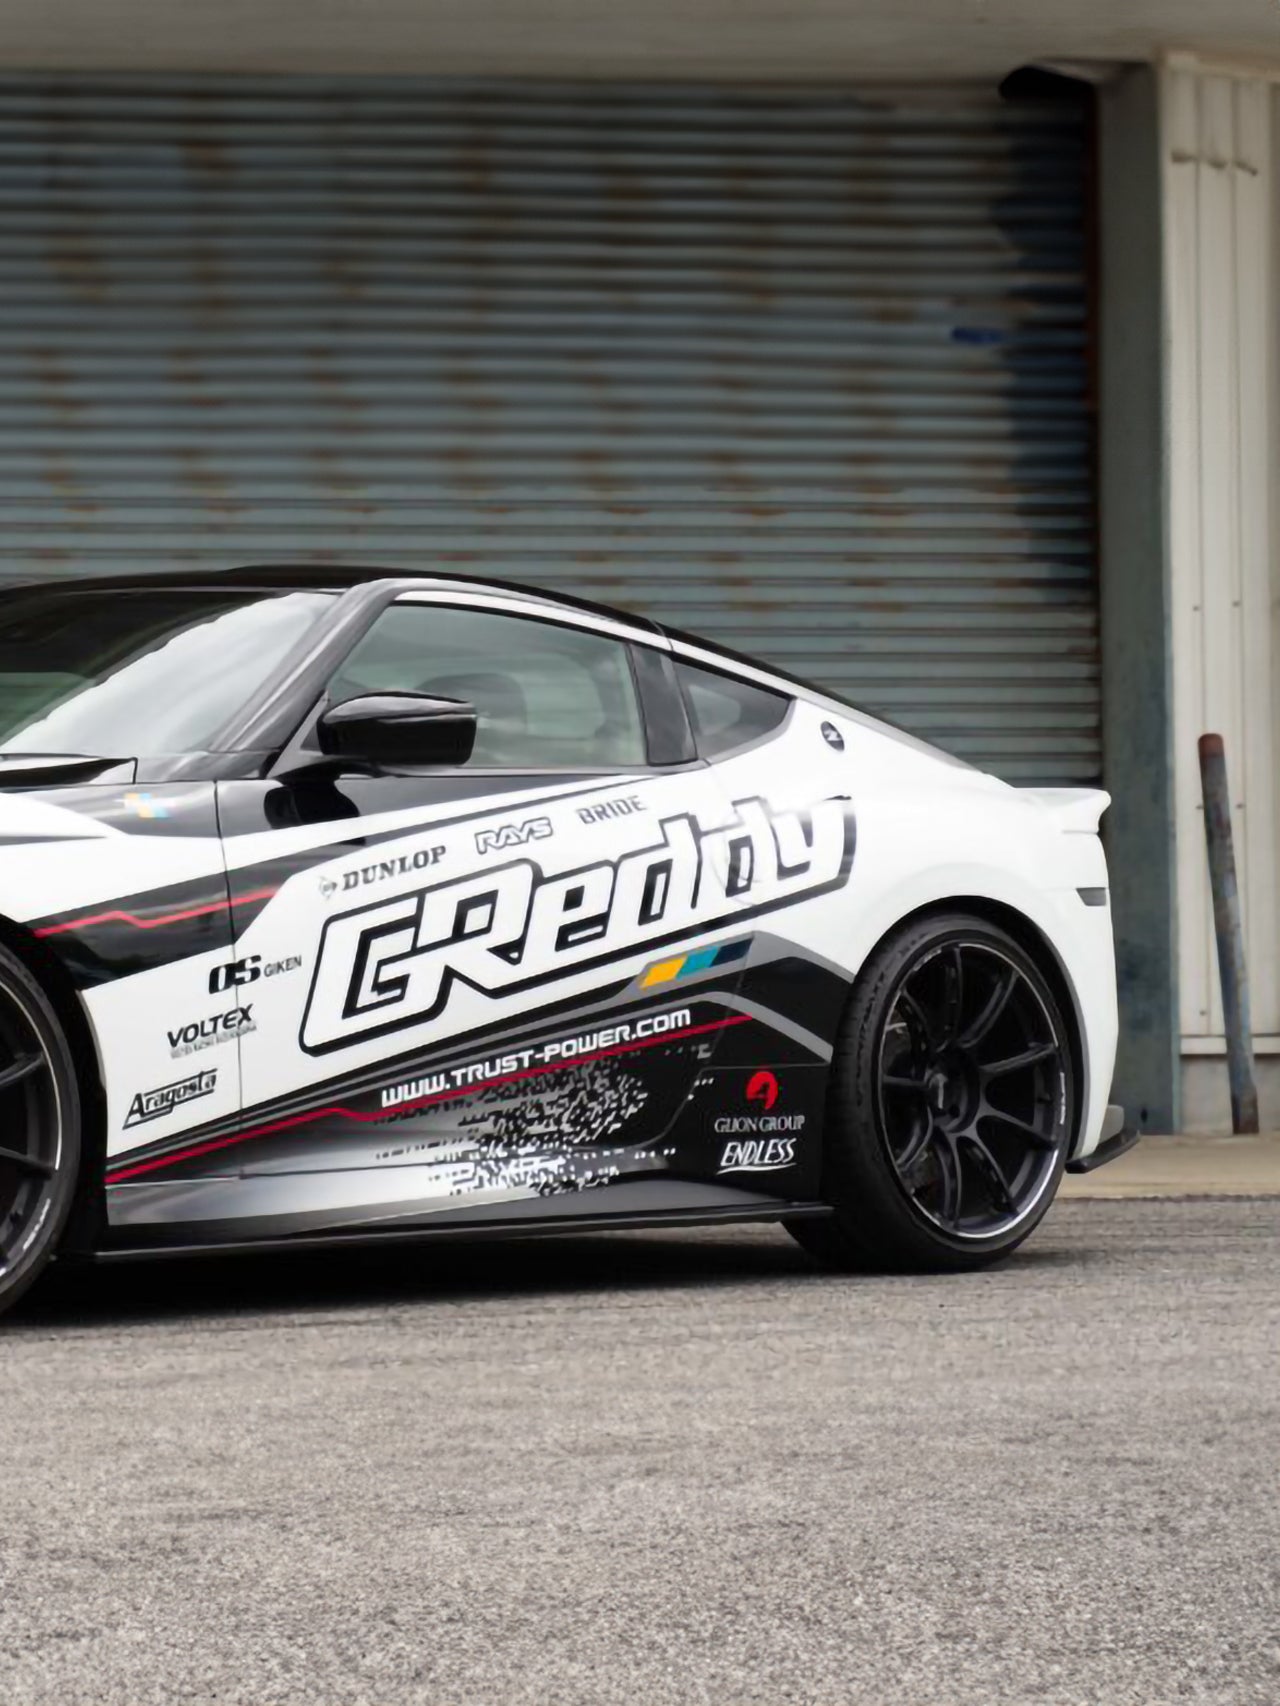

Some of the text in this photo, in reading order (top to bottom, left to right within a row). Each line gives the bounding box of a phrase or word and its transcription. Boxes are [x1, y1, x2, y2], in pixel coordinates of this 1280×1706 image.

[576, 795, 648, 825] BRIDE
[475, 817, 553, 855] RAYS
[342, 846, 447, 891] DUNLOP
[208, 955, 302, 994] OS GIKEN
[167, 1003, 254, 1048] VOLTEX
[122, 1067, 218, 1131] Aragosta
[759, 1114, 806, 1132] GROUP
[720, 1138, 797, 1167] ENDLESS
